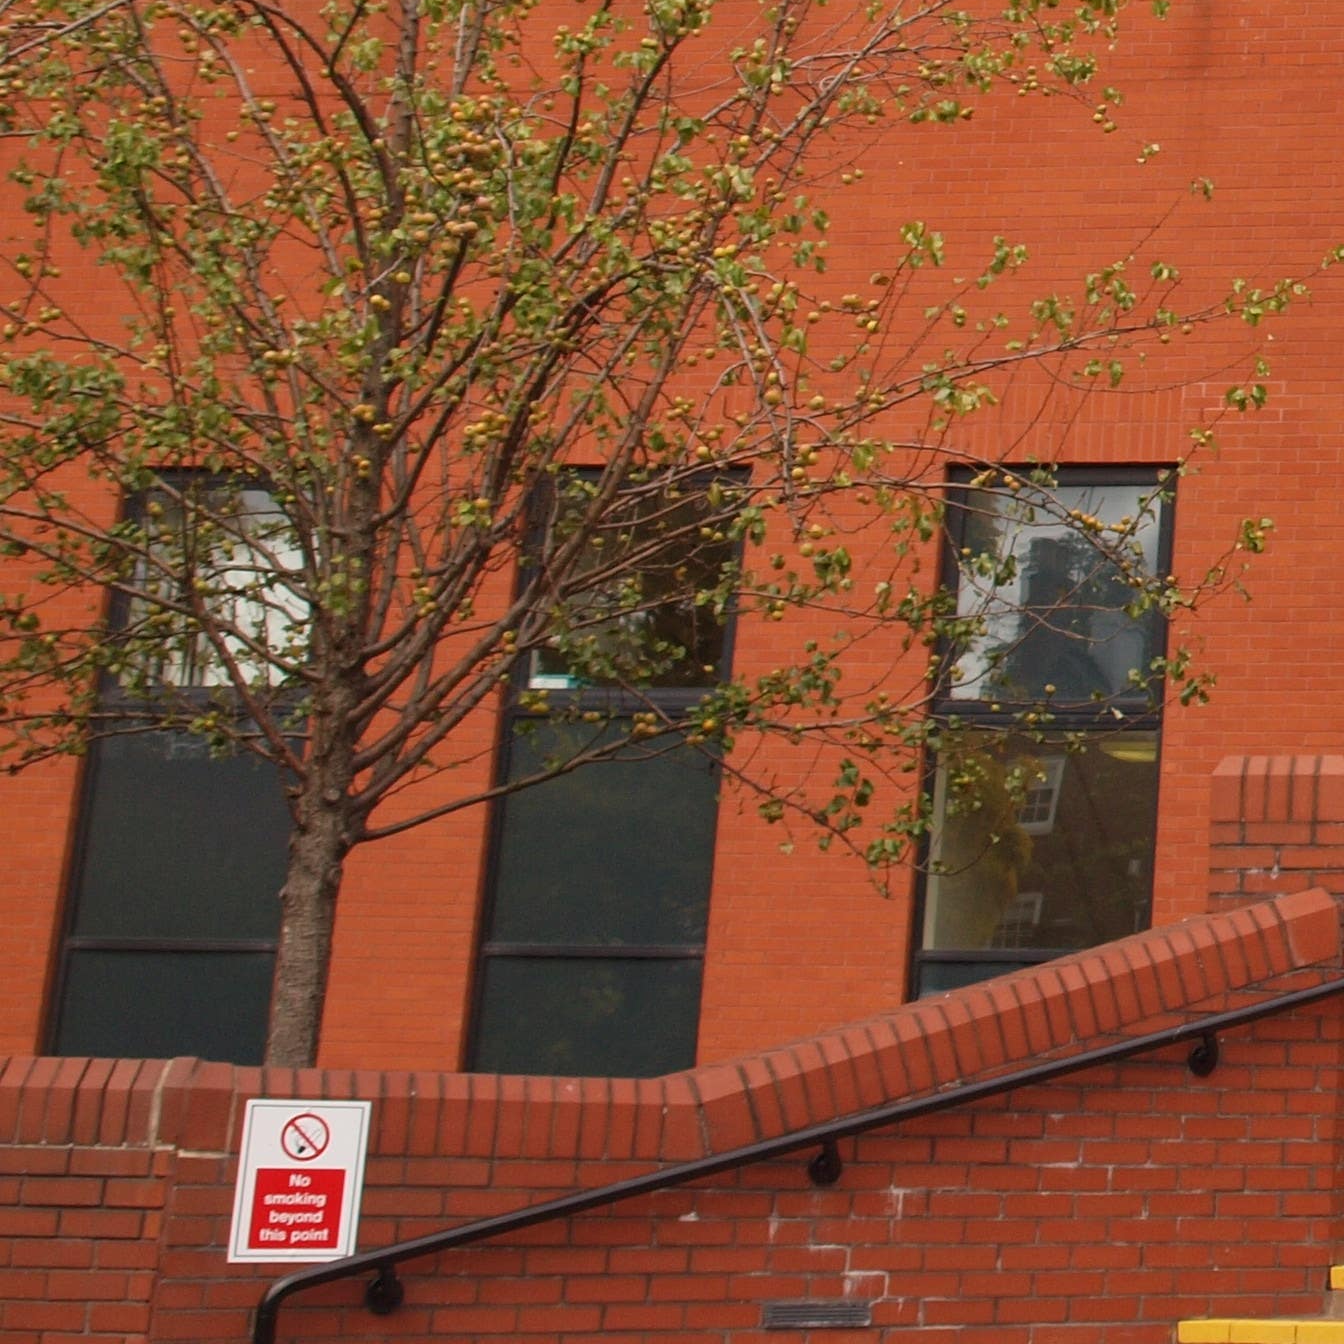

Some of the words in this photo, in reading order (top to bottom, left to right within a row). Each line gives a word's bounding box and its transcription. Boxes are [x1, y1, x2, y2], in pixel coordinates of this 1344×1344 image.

[288, 1174, 311, 1187] No
[264, 1192, 327, 1207] smoking
[269, 1210, 324, 1225] beyond
[259, 1228, 286, 1241] this
[290, 1228, 329, 1244] point
